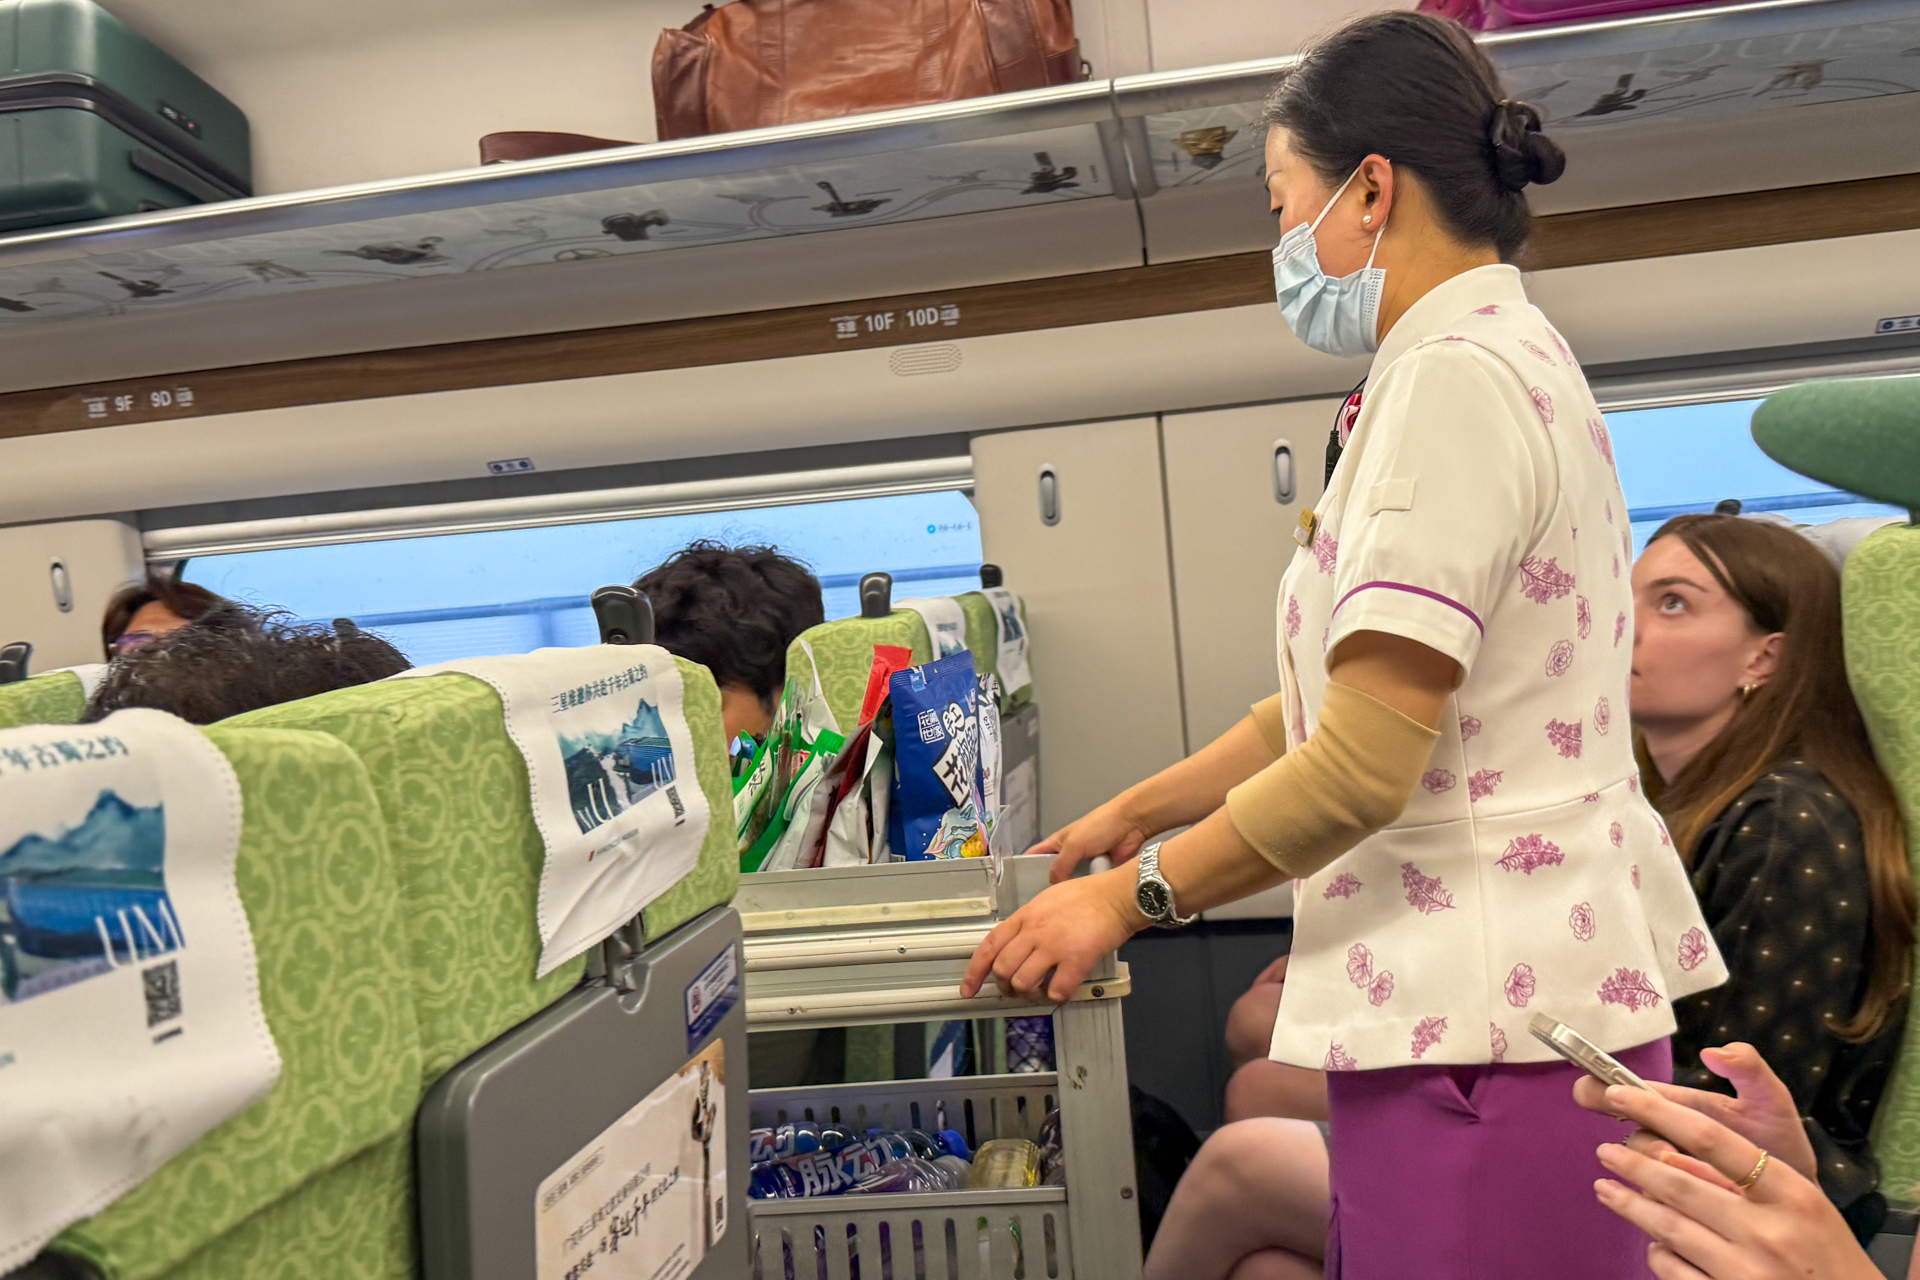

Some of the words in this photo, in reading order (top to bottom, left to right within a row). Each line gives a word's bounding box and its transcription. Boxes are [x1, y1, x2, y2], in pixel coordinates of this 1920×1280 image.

[864, 311, 895, 332] 10F
[906, 306, 939, 328] 10D
[115, 394, 134, 412] 9F
[150, 390, 172, 408] 9D
[0, 735, 129, 774] 年古蜀之约
[797, 1136, 894, 1198] 脉动
